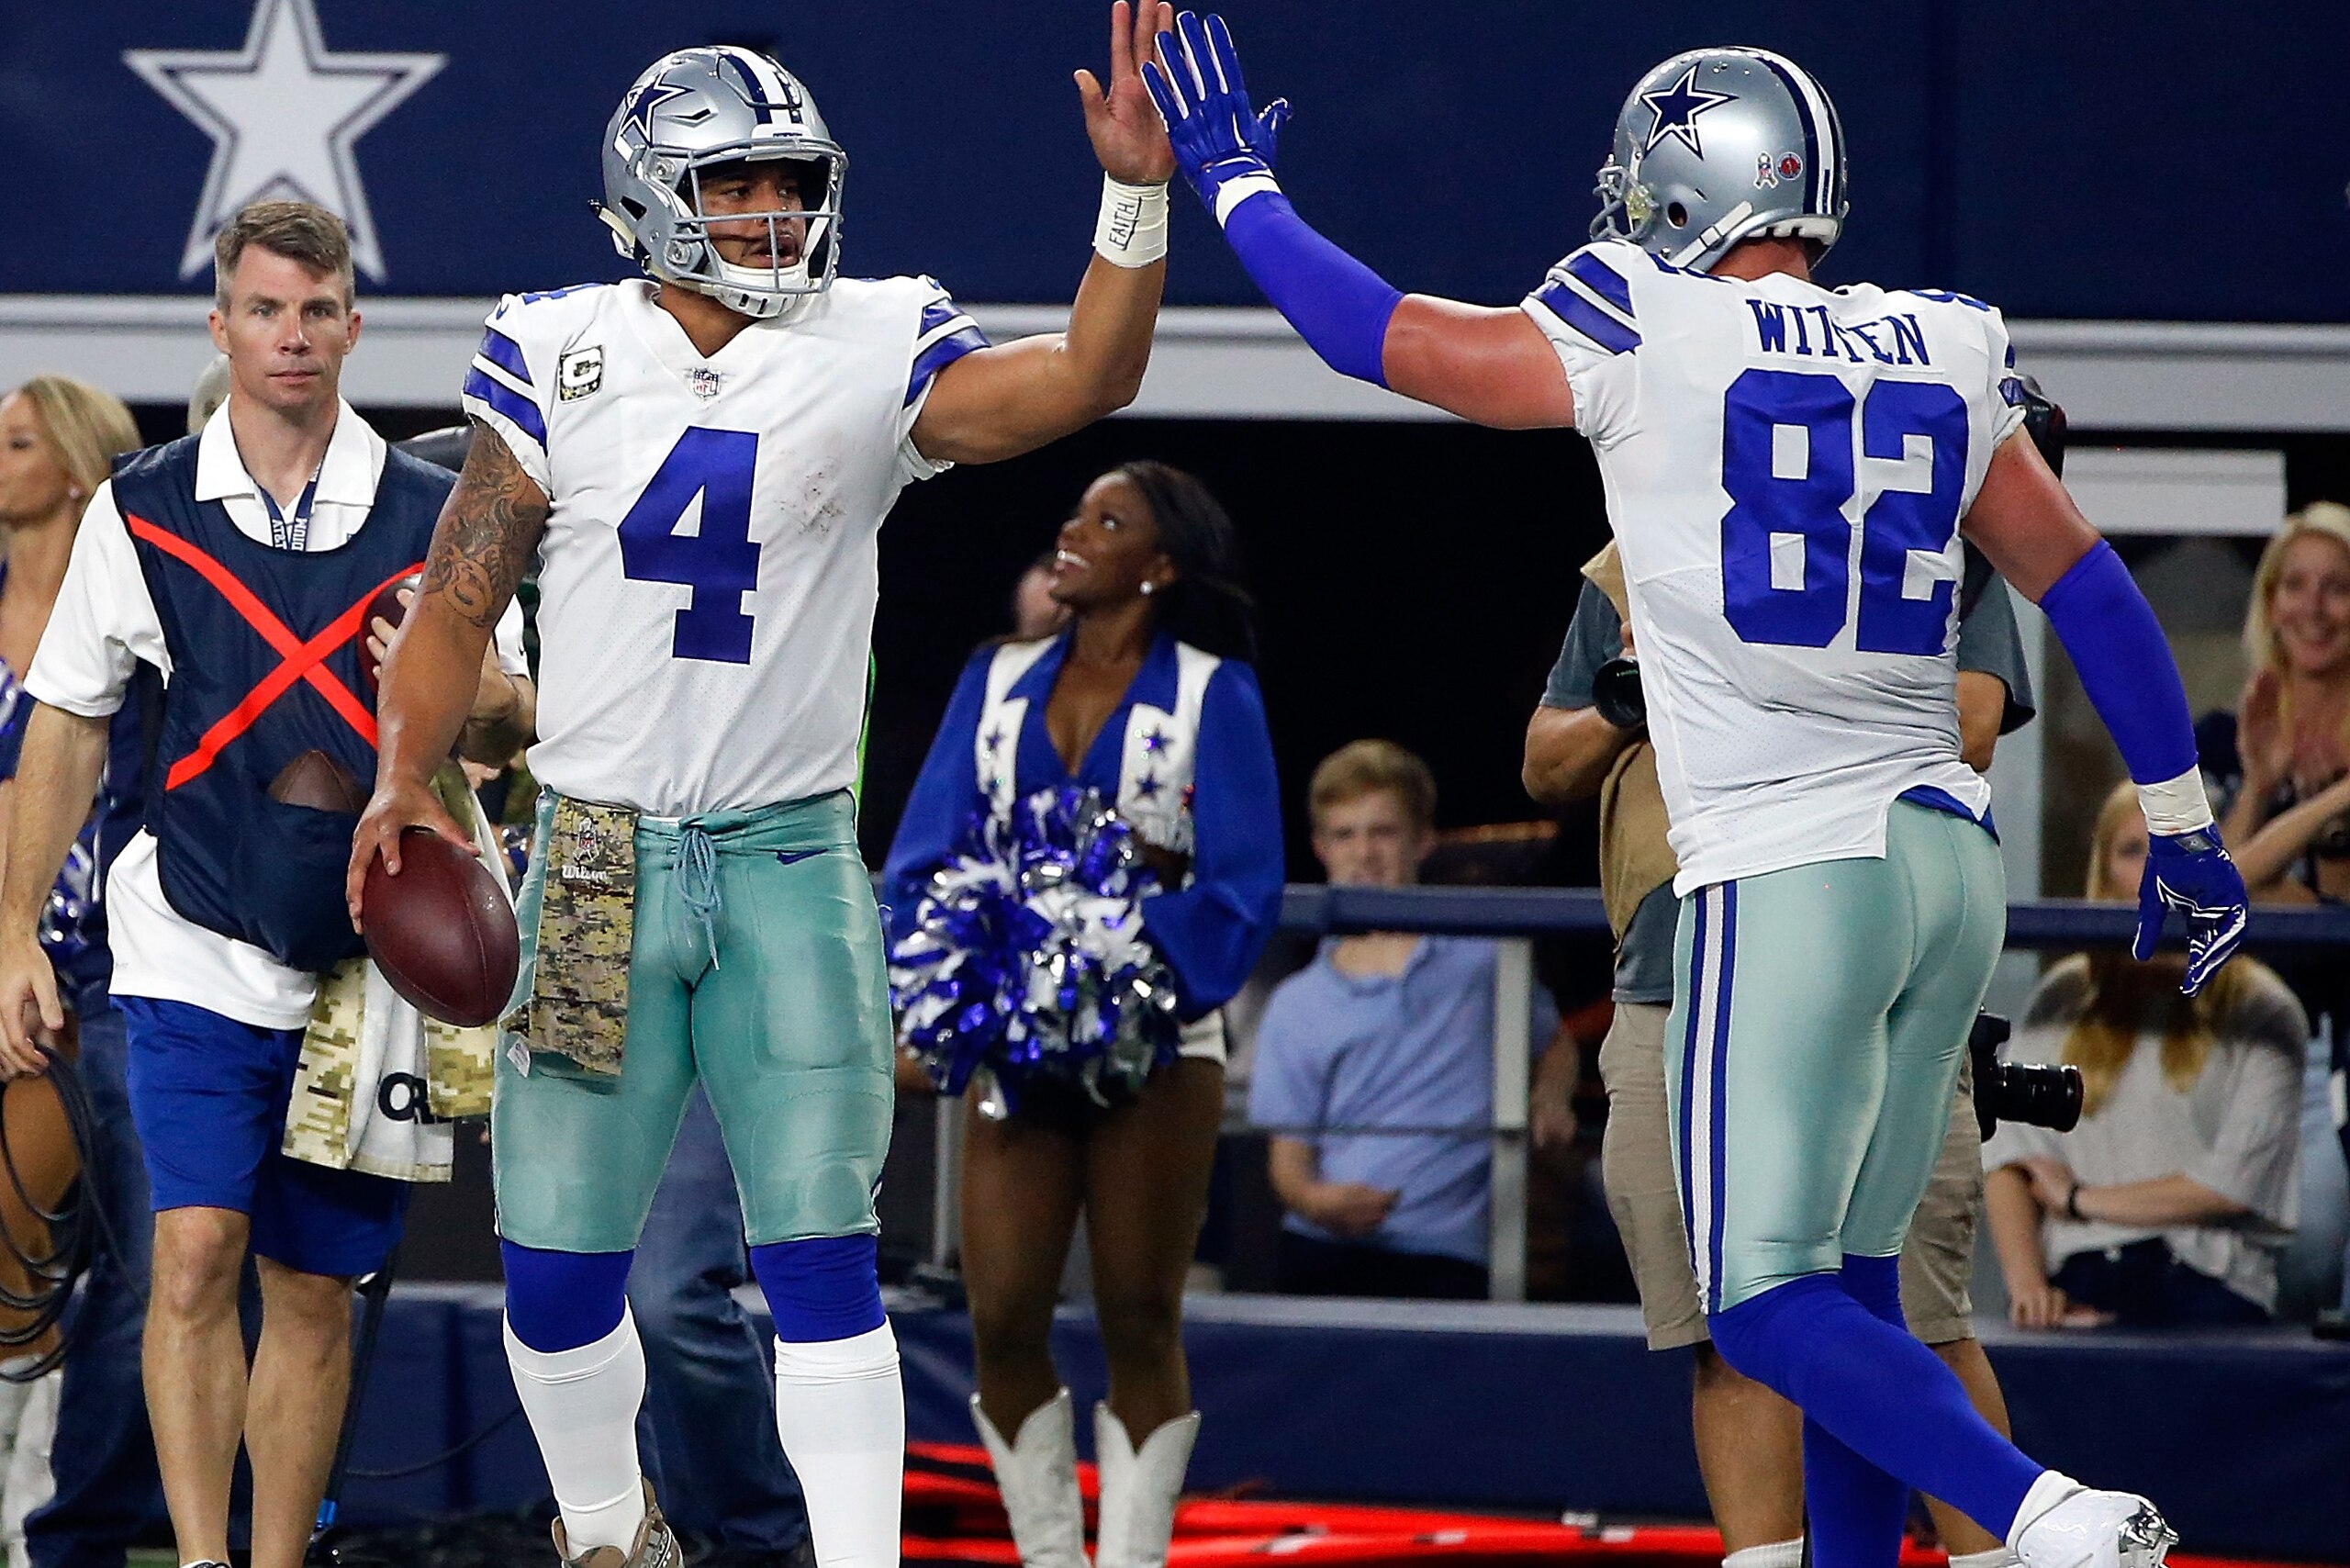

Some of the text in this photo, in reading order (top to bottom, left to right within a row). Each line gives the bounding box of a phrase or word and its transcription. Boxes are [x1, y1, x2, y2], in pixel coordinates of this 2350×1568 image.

[1107, 201, 1137, 250] FAITH
[562, 346, 602, 387] C
[272, 519, 287, 550] AT&T
[1722, 367, 1969, 657] 82
[619, 426, 760, 664] 4
[562, 864, 608, 882] Wilson
